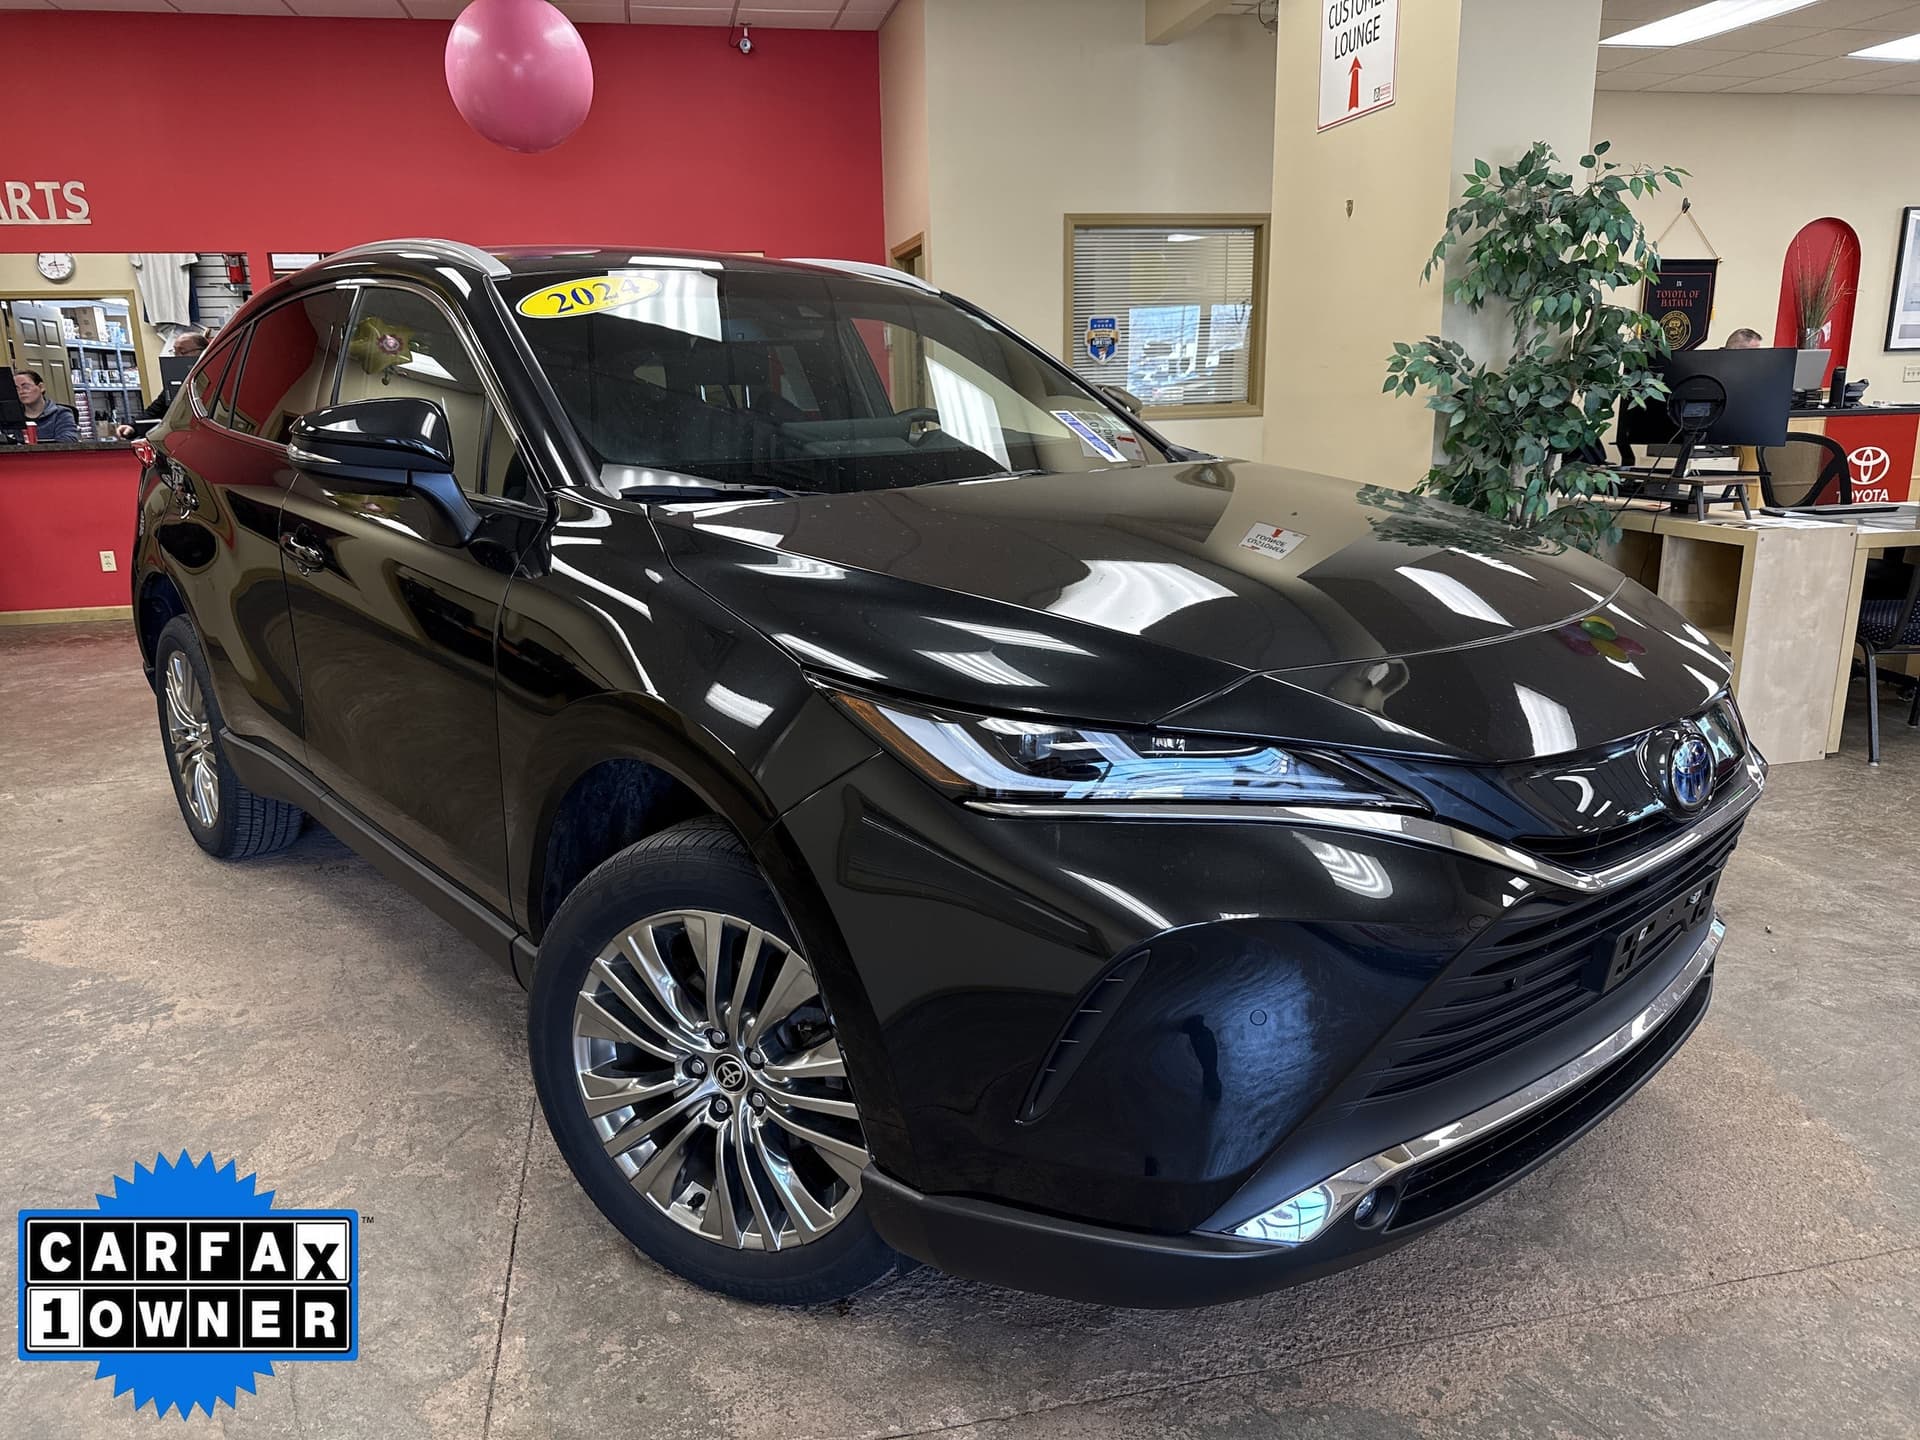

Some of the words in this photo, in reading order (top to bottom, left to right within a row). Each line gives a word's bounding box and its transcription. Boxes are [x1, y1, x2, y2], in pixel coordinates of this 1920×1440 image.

[1329, 0, 1385, 30] CUSTO
[1334, 15, 1381, 60] LOUNGE
[547, 279, 641, 313] 2024
[1656, 290, 1687, 299] TOYOTA
[1689, 290, 1700, 298] OF
[1836, 488, 1889, 503] TYOTA
